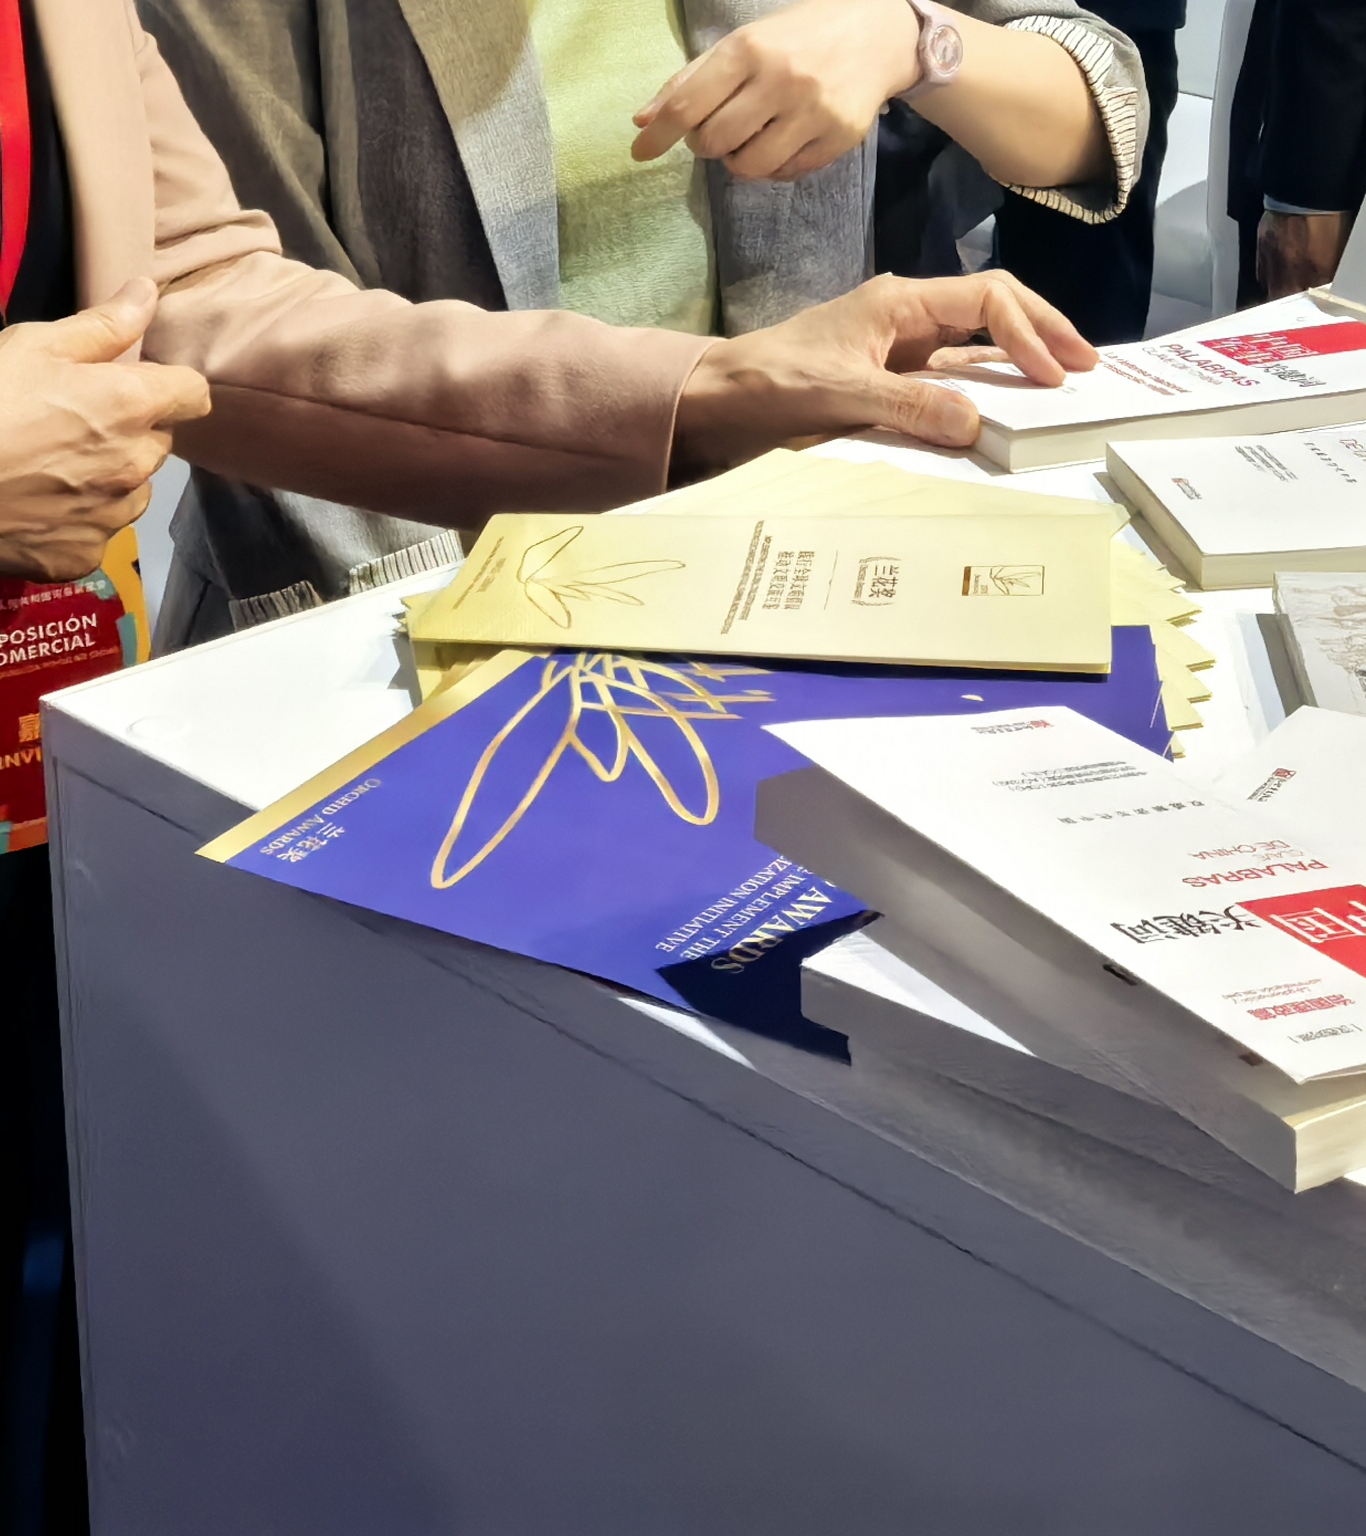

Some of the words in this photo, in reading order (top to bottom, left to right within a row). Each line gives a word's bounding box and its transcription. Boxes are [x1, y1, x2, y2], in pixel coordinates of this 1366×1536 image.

[1159, 343, 1261, 388] PALABRAS
[260, 814, 325, 855] AWARDS
[1191, 843, 1257, 861] CHINA
[1182, 859, 1330, 889] PALABRAS
[655, 897, 736, 953] INITIATIVE
[715, 873, 806, 938] IMPLEMENT
[1109, 904, 1263, 944] 关键词
[679, 937, 722, 961] THE
[711, 886, 833, 974] AWARDS
